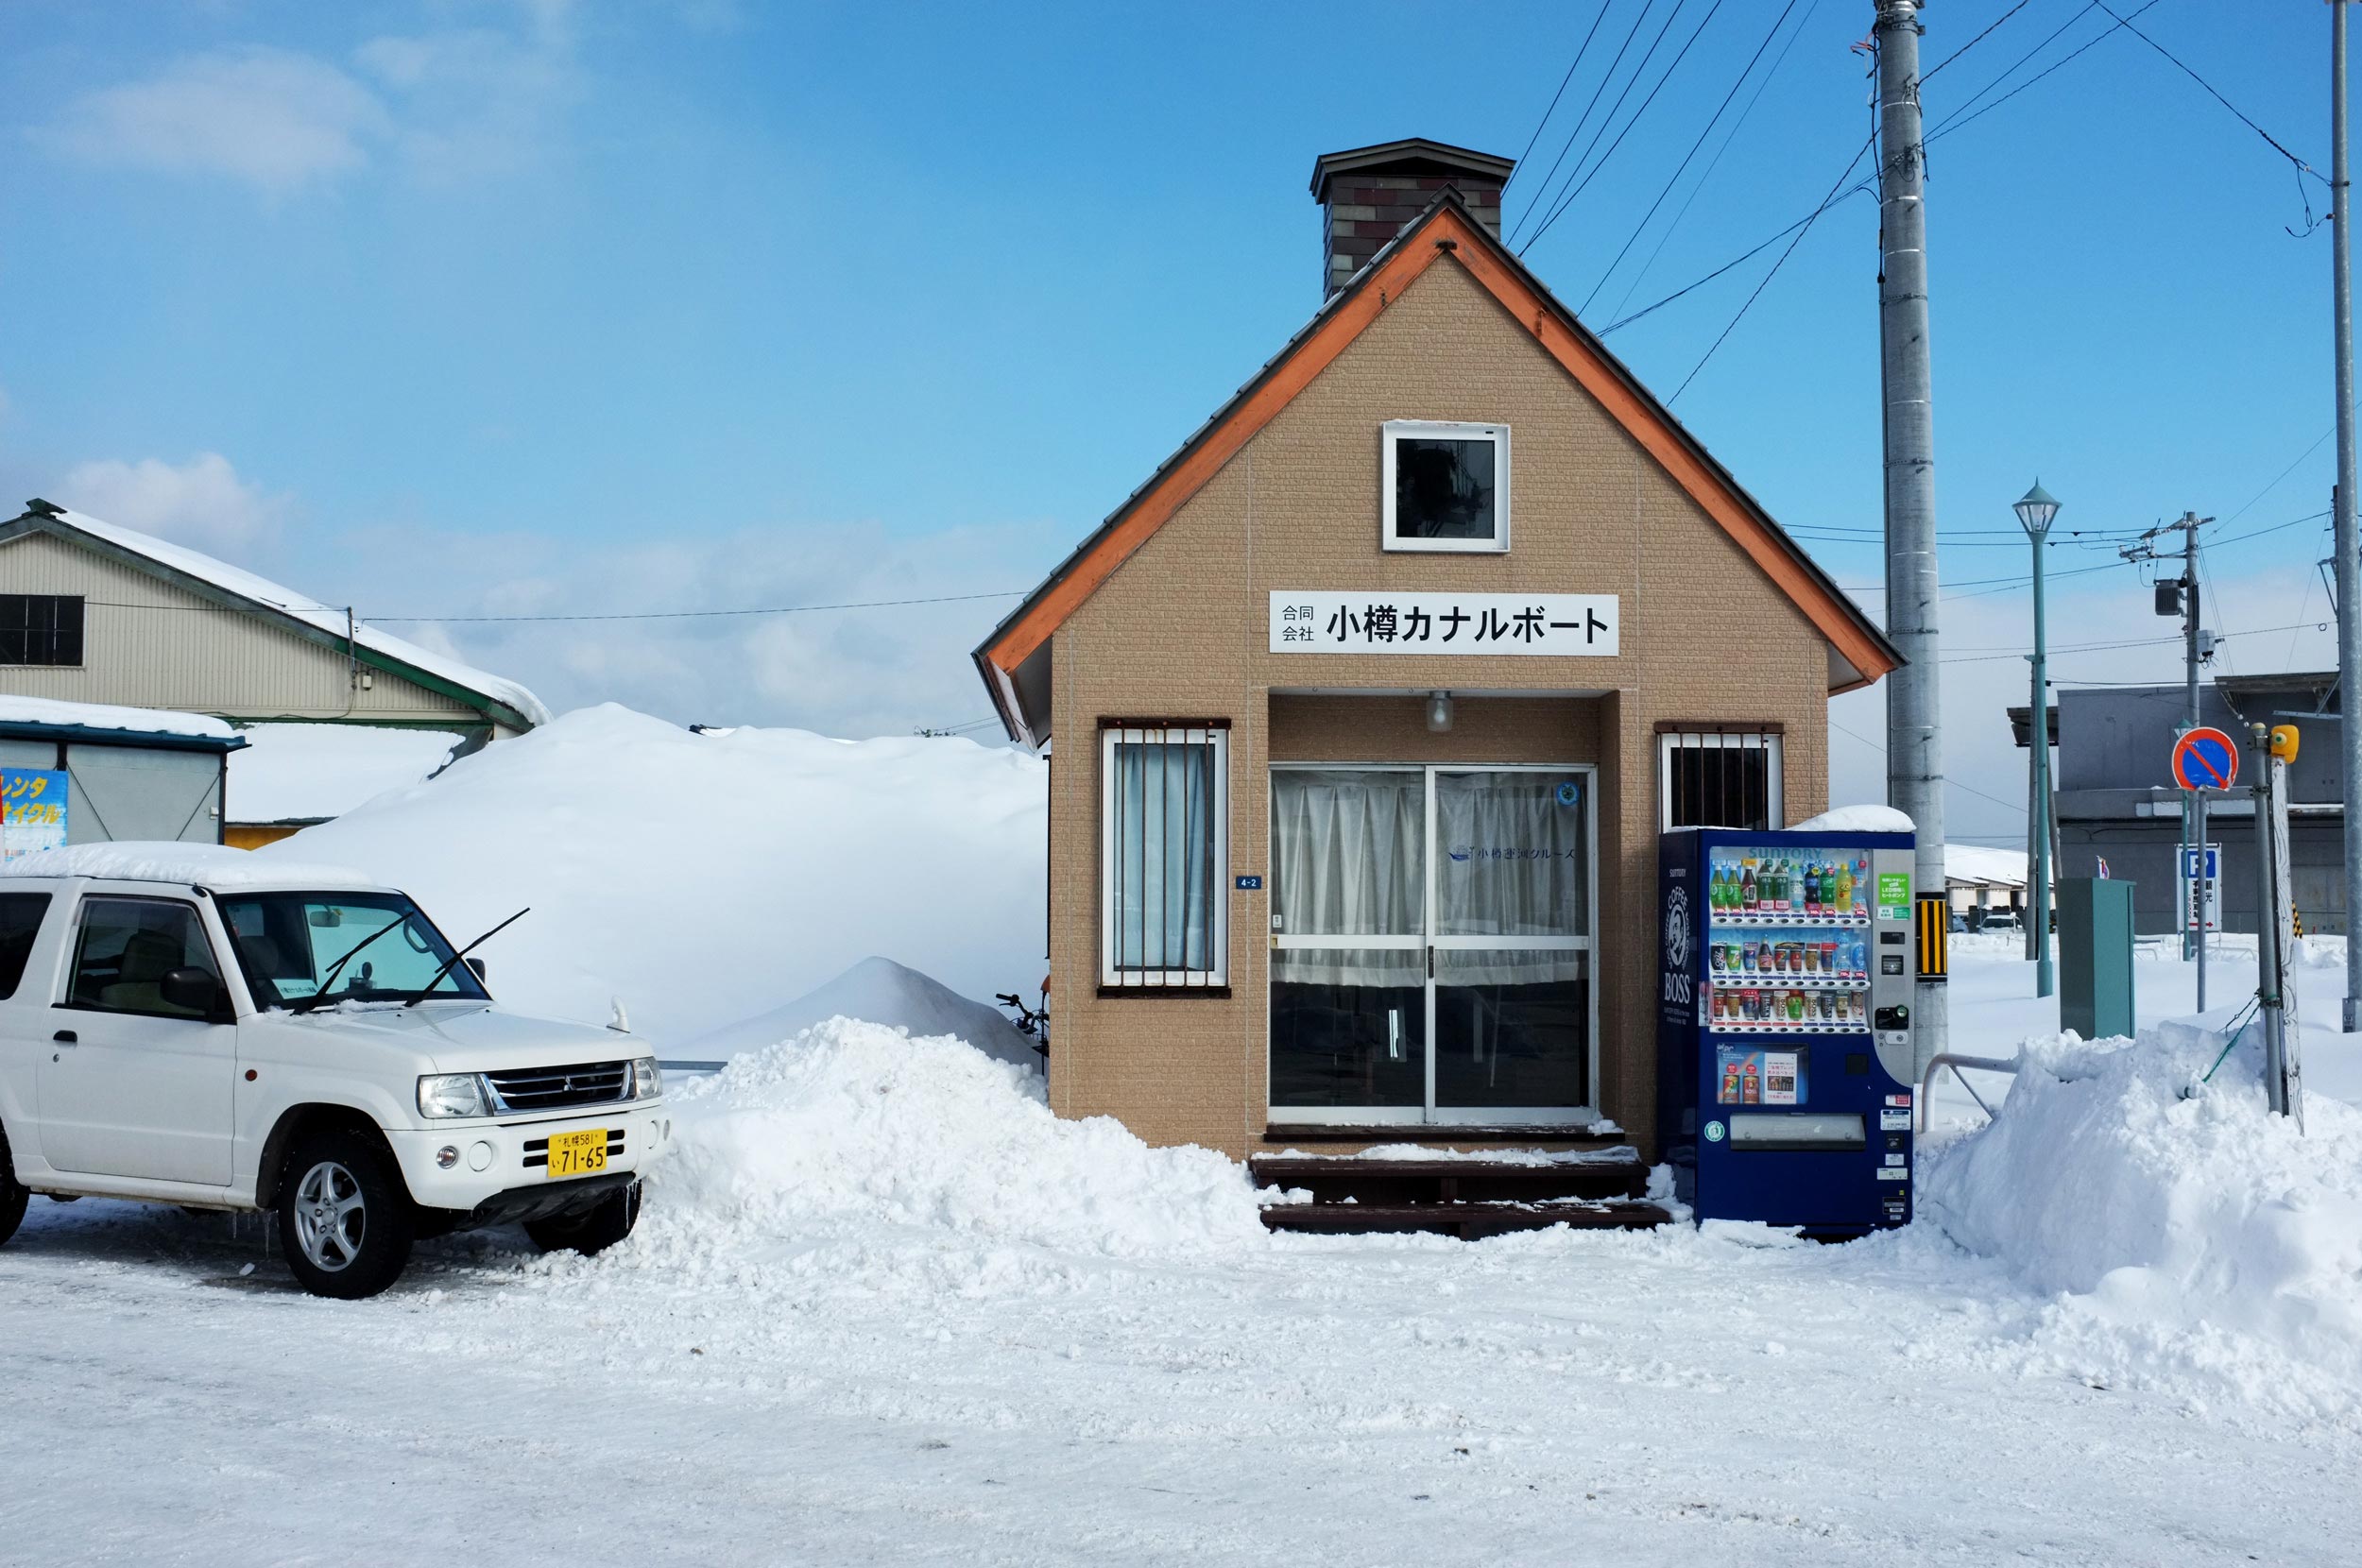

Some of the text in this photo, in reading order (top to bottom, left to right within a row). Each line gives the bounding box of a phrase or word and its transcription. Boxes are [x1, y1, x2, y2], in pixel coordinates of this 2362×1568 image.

[1282, 605, 1314, 621] 合同
[1282, 626, 1314, 641] 会社
[1326, 605, 1608, 643] 小樽カナルボート
[2189, 854, 2209, 875] P
[1241, 878, 1257, 887] 4-2
[1664, 972, 1690, 1004] BOSS
[552, 1146, 604, 1172] い 71-65
